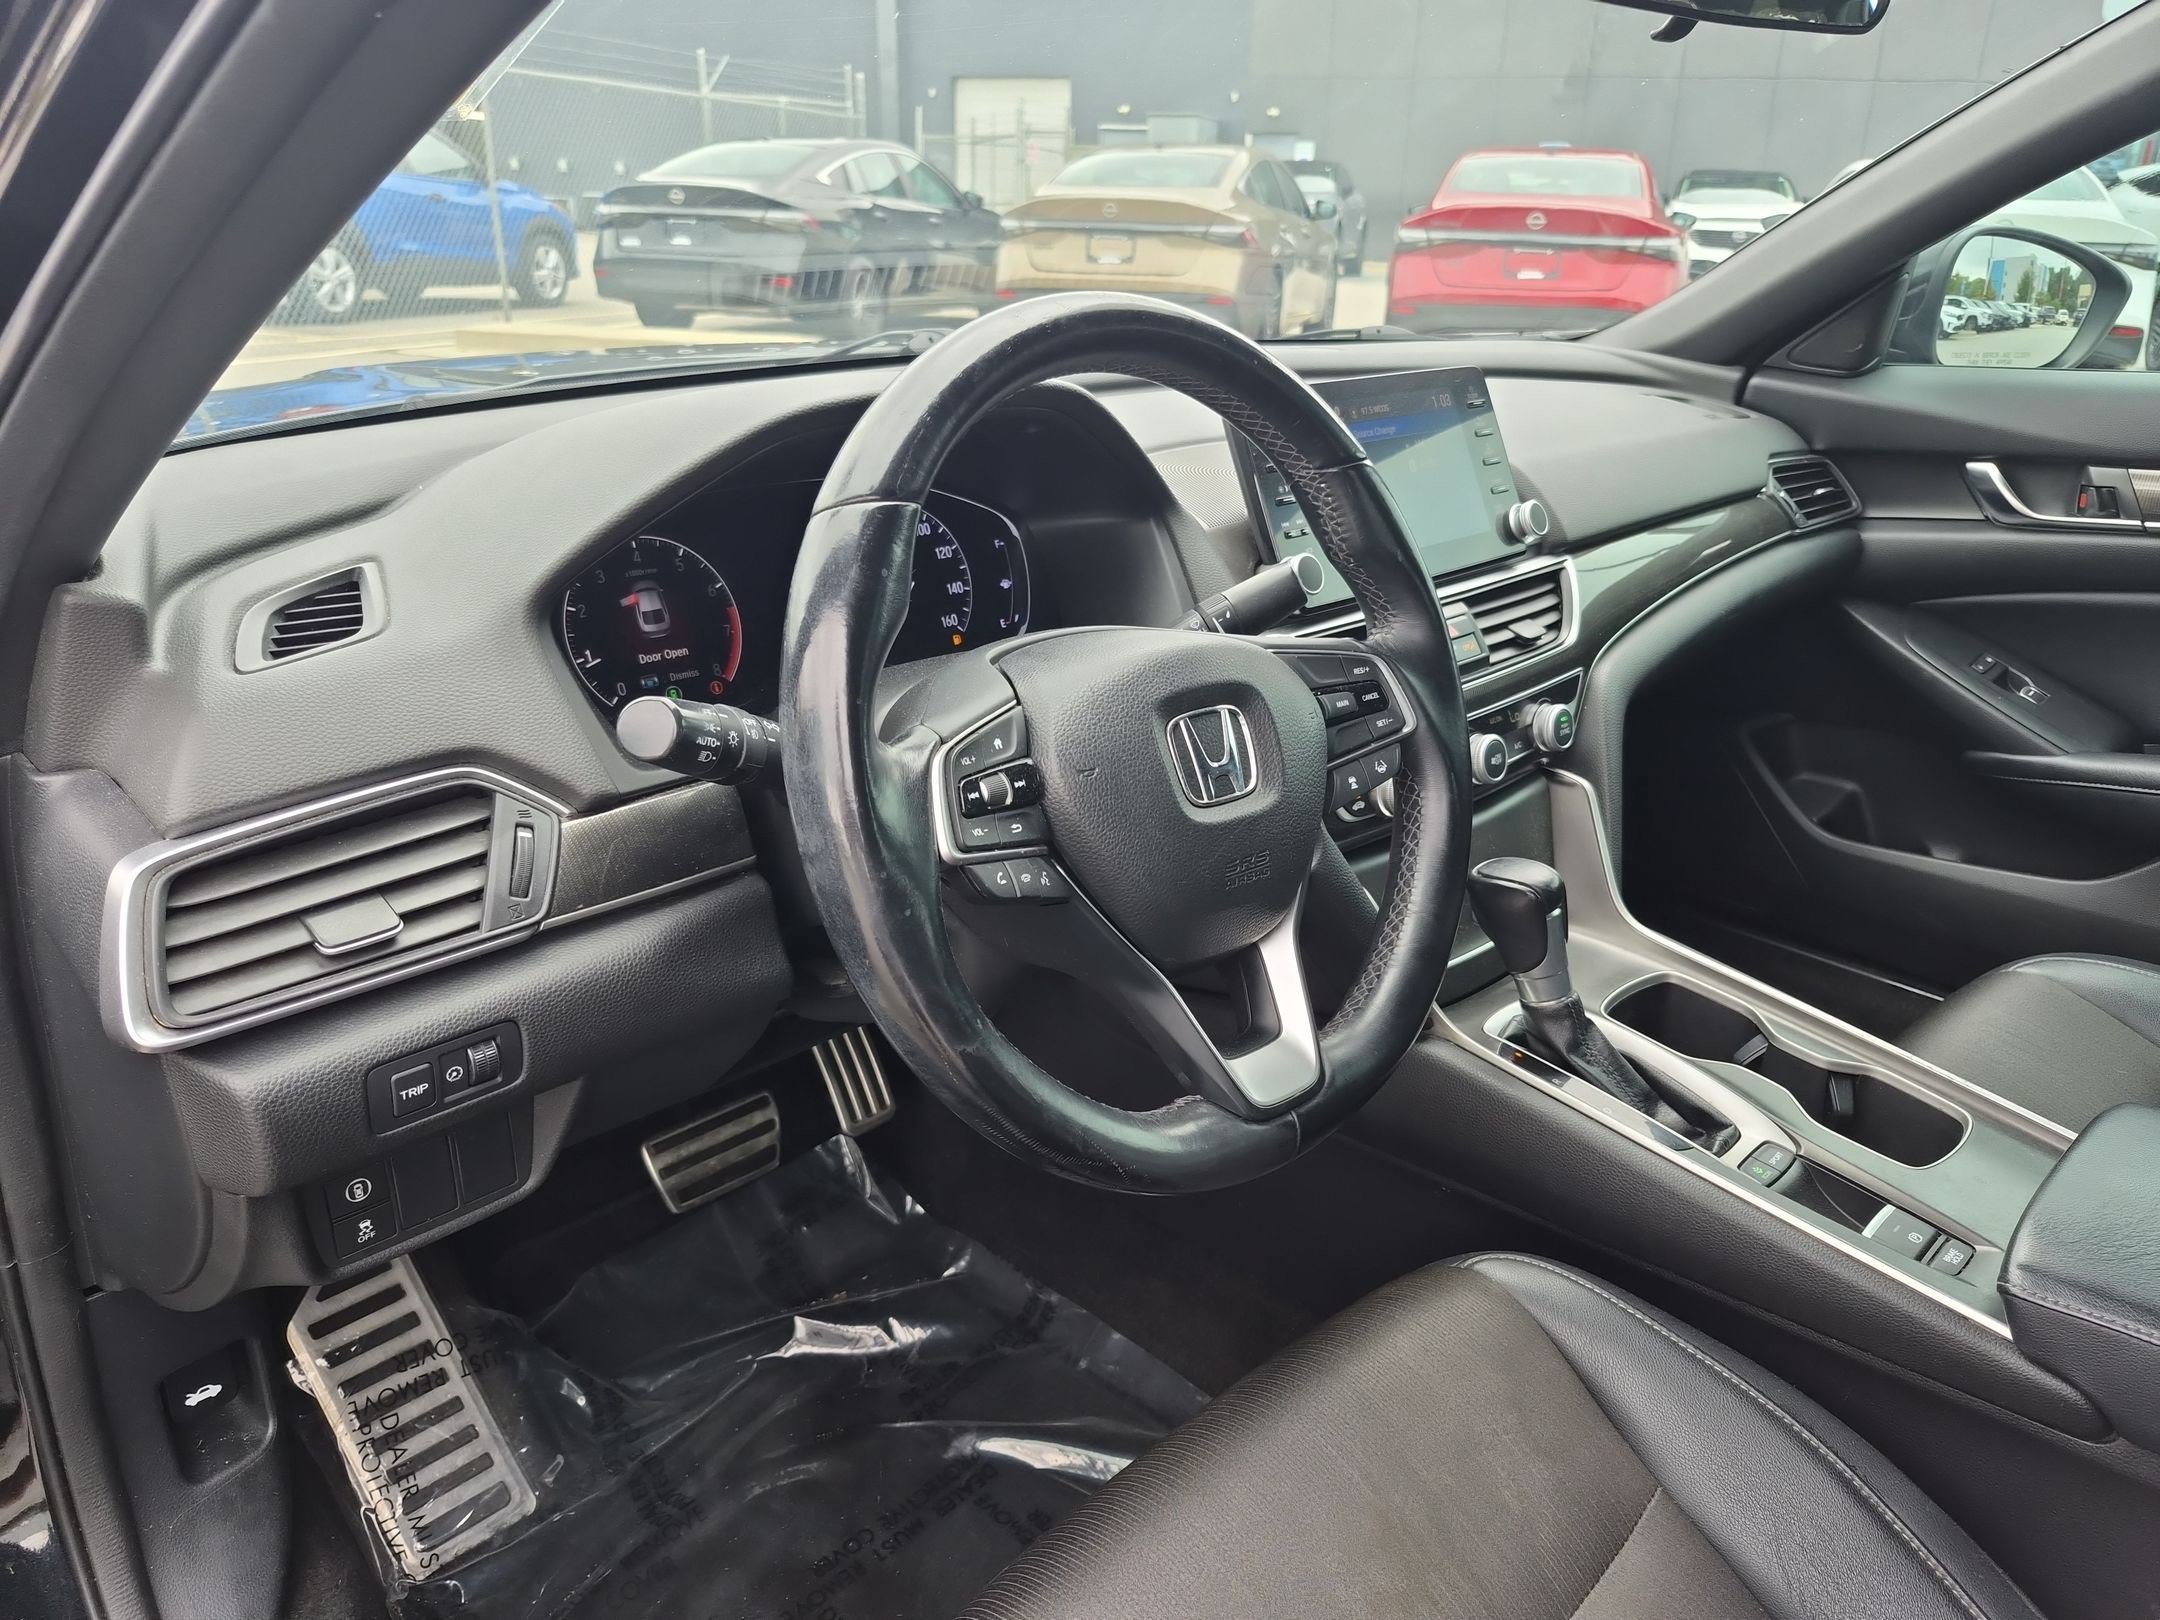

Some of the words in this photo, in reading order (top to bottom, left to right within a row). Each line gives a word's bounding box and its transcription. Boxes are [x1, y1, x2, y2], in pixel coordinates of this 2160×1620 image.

[916, 522, 931, 536] 00
[633, 550, 641, 562] 4
[935, 545, 953, 560] 120
[675, 558, 685, 572] 5
[595, 569, 606, 584] 3
[708, 585, 717, 598] 6
[946, 581, 965, 596] 140
[578, 604, 587, 619] 2
[941, 613, 959, 629] 160
[1000, 618, 1007, 629] E
[723, 624, 731, 637] 7
[638, 653, 662, 665] Door
[664, 647, 690, 660] Open
[669, 668, 700, 682] Dismiss
[713, 663, 722, 677] 8
[617, 682, 627, 696] 0
[1336, 699, 1350, 708] MAIN
[1361, 692, 1380, 702] CANCEL
[696, 736, 717, 748] AUTO
[399, 1082, 429, 1100] TRIP
[1768, 1151, 1784, 1165] SPORT
[357, 1231, 376, 1244] OFF
[348, 1367, 449, 1420] REMOVE
[379, 1412, 420, 1503] DEALER
